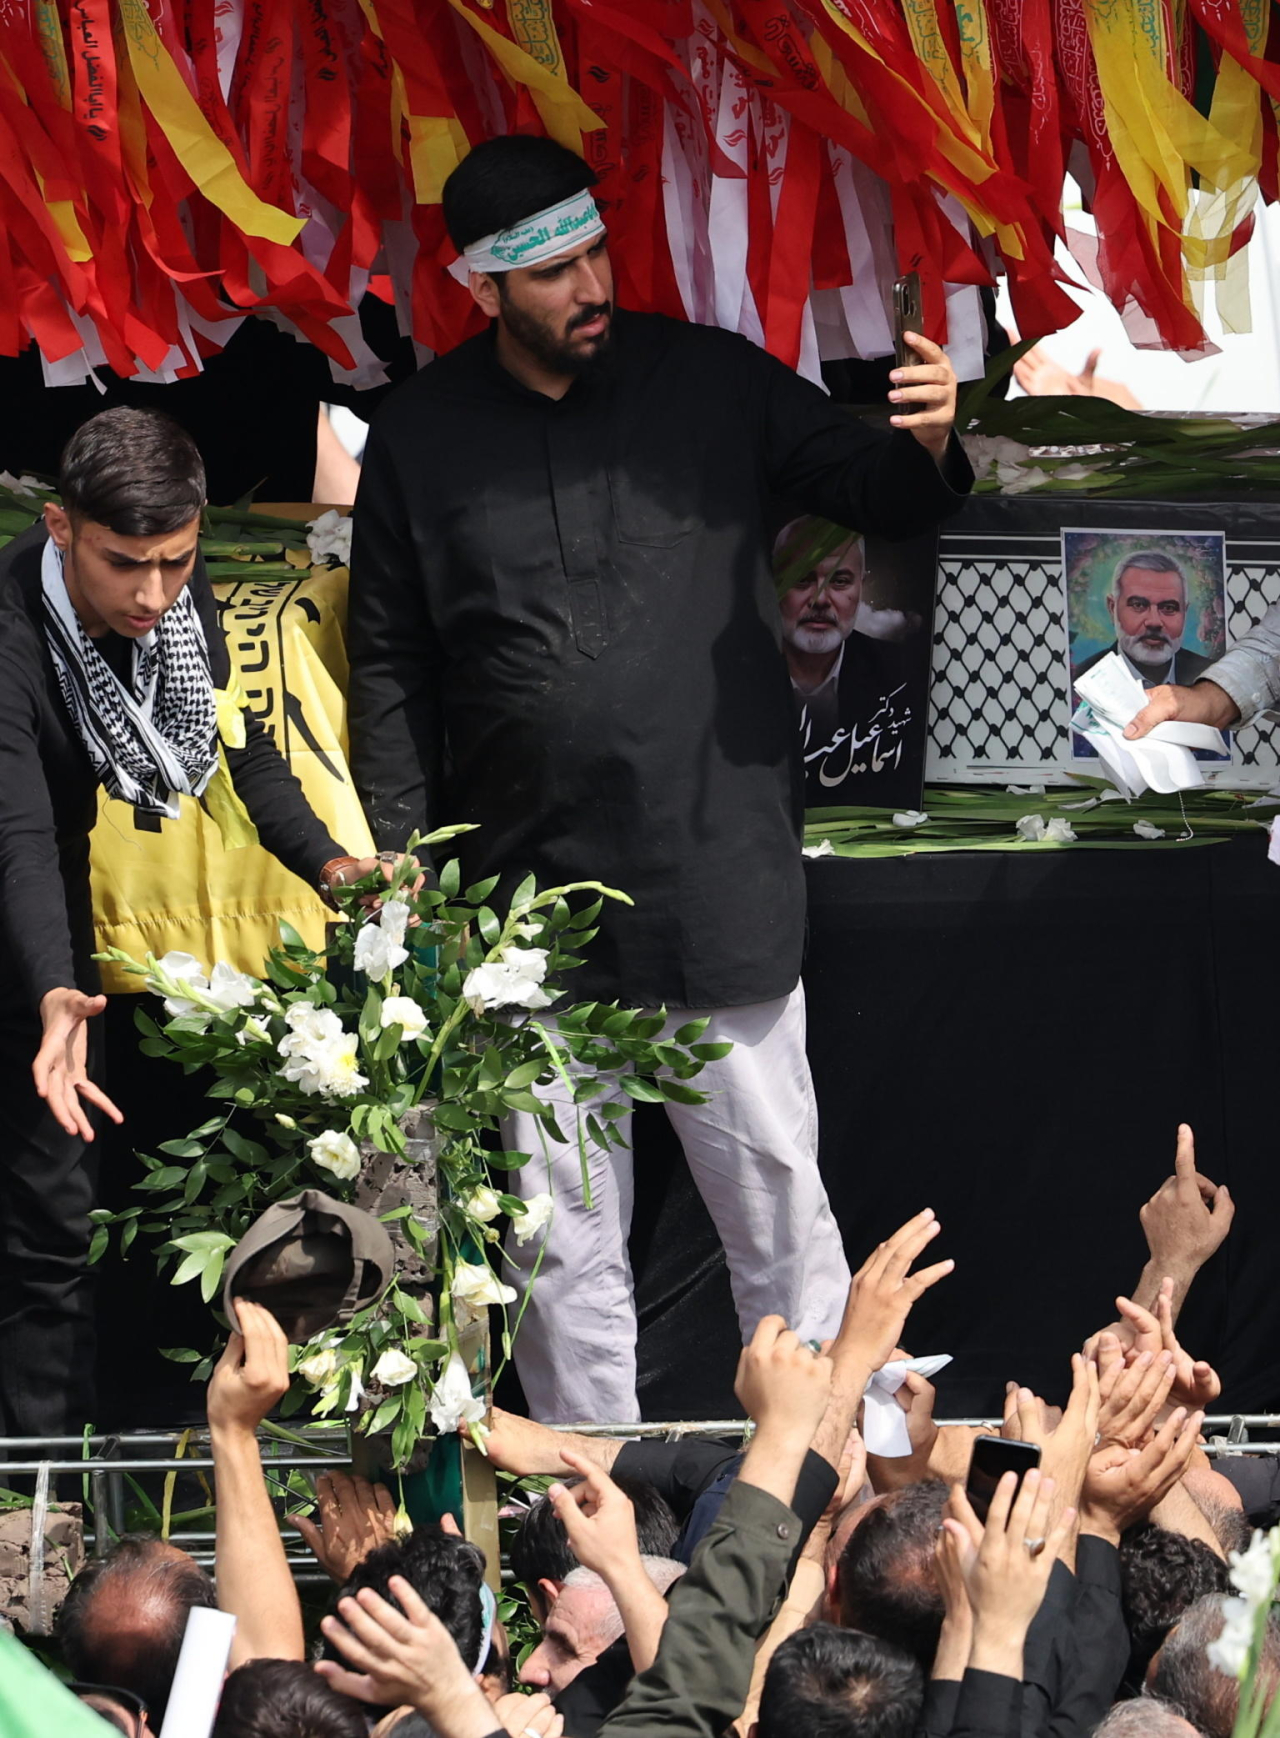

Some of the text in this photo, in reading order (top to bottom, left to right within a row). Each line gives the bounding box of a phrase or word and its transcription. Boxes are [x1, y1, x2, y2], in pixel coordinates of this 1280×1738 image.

[868, 681, 912, 735] شهید دکتر
[819, 722, 904, 788] اسماعیل
